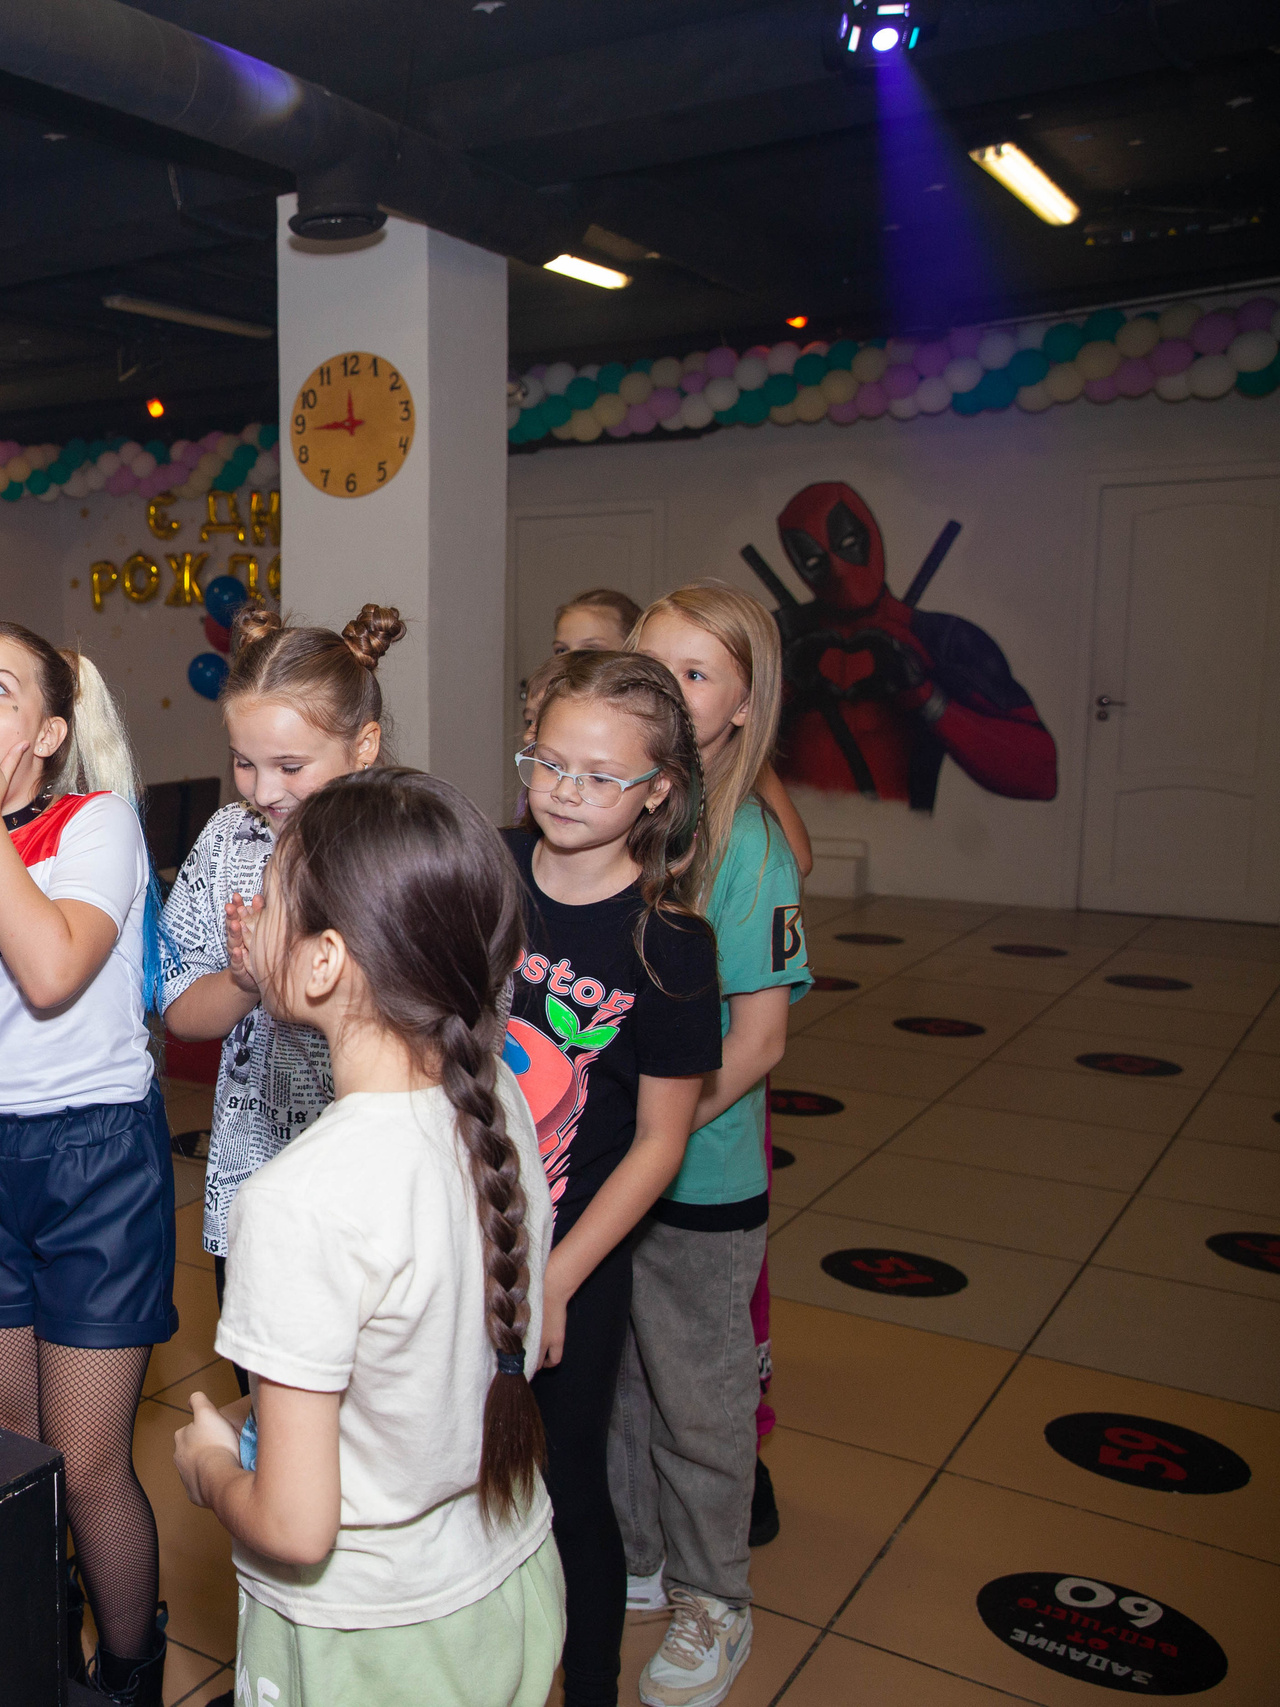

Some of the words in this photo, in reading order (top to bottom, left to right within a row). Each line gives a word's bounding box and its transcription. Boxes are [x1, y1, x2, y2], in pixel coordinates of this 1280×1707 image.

[320, 366, 331, 386] 11
[342, 355, 360, 377] 12
[370, 357, 379, 377] 1
[389, 372, 402, 392] 2
[301, 389, 317, 409] 10
[399, 400, 411, 421] 3
[295, 414, 306, 435] 9
[298, 445, 309, 464] 8
[399, 436, 410, 455] 4
[321, 468, 330, 487] 7
[377, 461, 388, 482] 5
[345, 473, 357, 493] 6
[286, 1106, 308, 1124] is
[1054, 1577, 1164, 1628] 60
[1018, 1597, 1179, 1658] ВЕДУЩЕГО
[1067, 1630, 1109, 1651] ОТ
[1010, 1628, 1153, 1685] ЗАДАНИЕ
